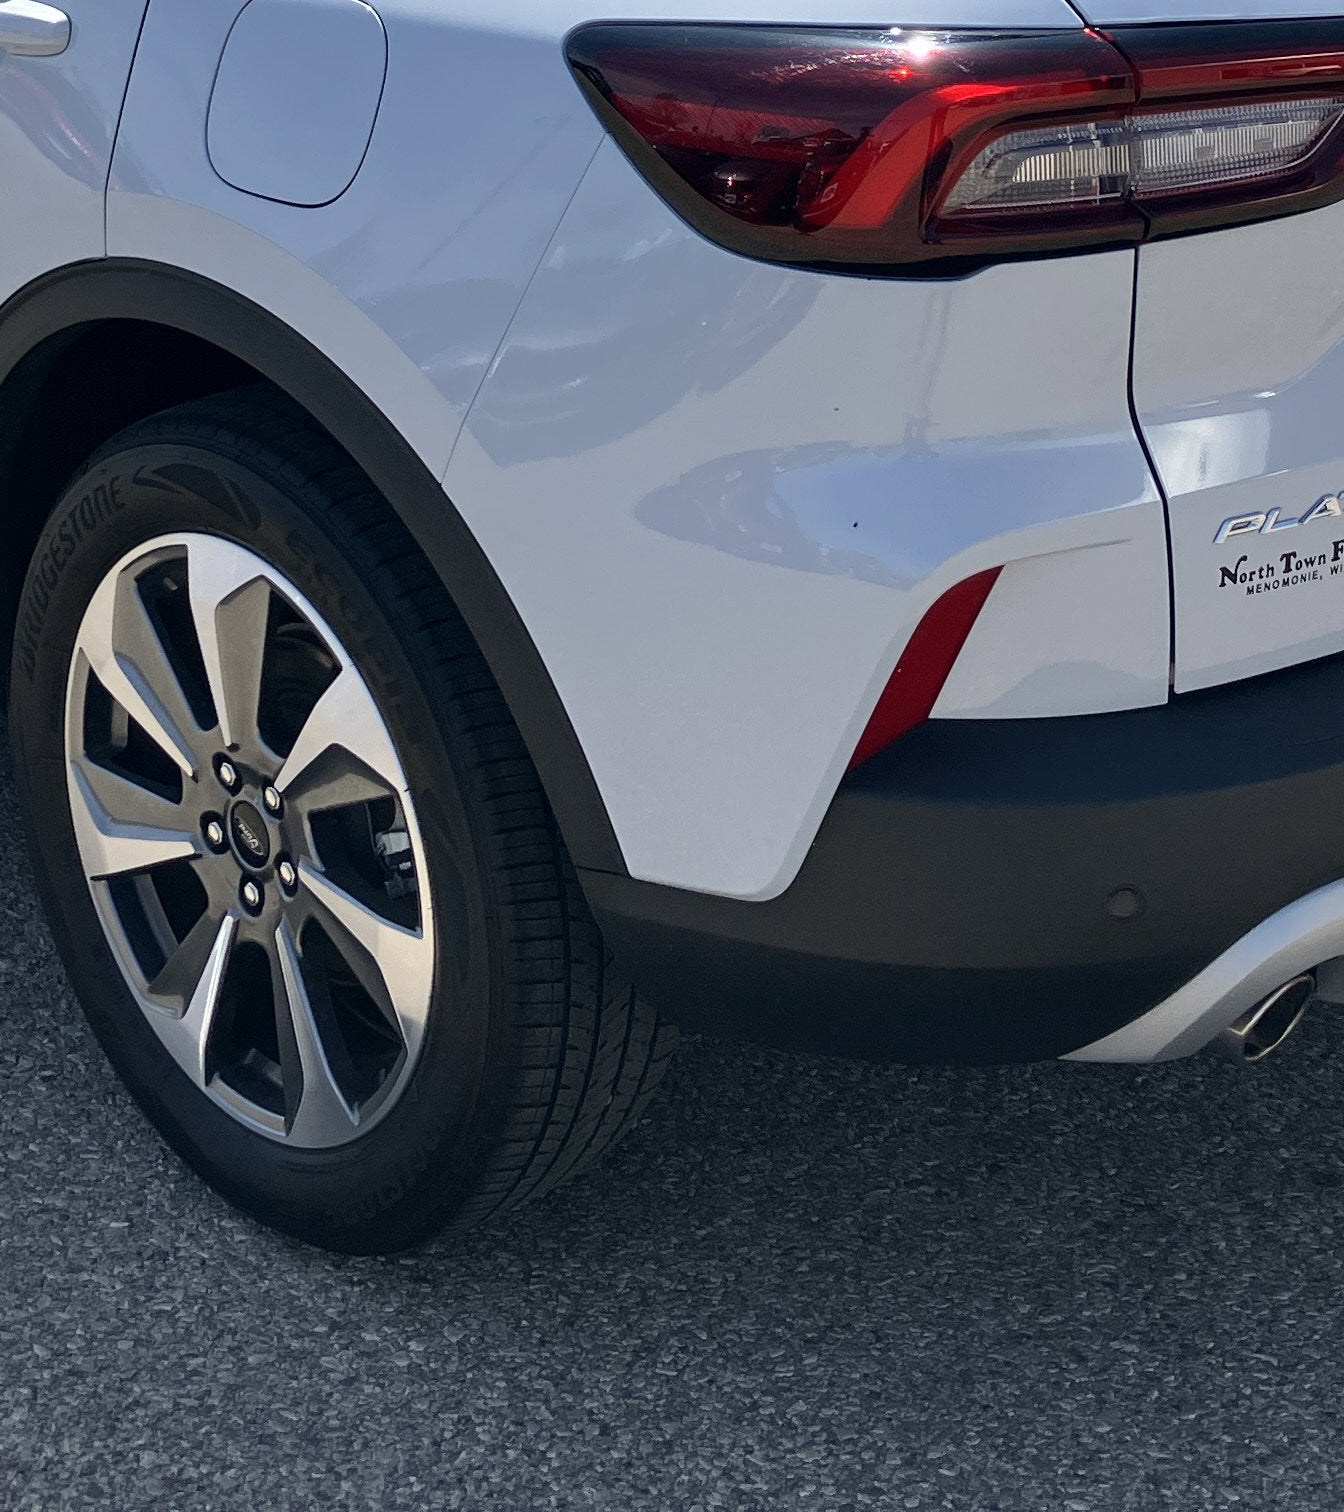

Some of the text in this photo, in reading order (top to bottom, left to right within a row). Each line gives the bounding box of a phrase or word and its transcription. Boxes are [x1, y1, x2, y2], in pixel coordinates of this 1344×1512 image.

[19, 474, 126, 683] BRIDGESTONE
[1218, 554, 1275, 588] North
[1280, 550, 1327, 574] Town
[1246, 563, 1344, 596] MENOMONIE, WI
